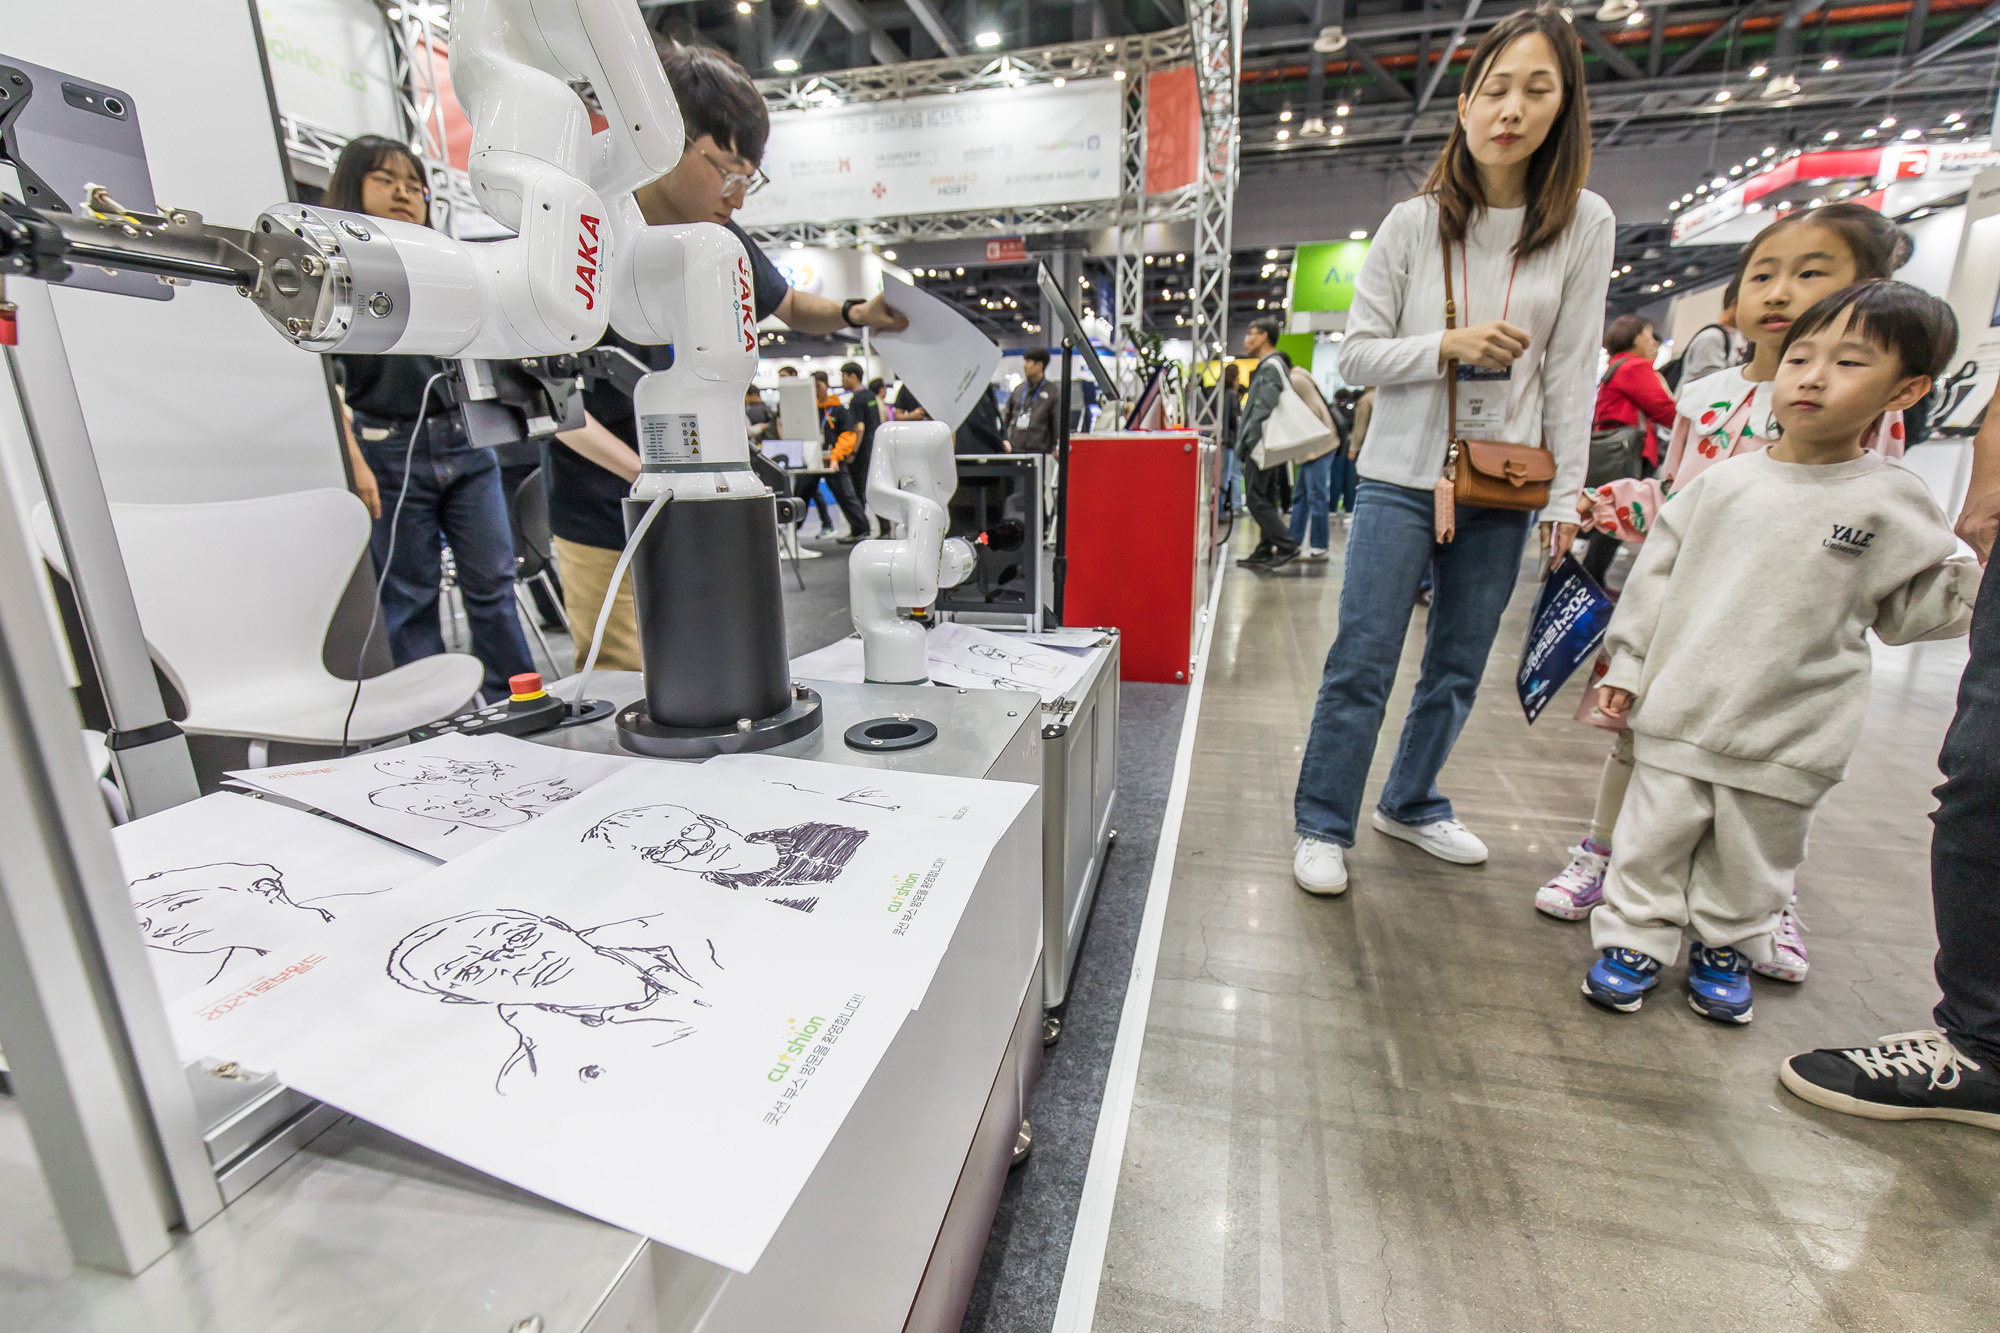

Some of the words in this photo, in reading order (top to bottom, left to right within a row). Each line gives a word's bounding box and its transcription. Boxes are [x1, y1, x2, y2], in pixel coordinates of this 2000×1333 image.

[574, 213, 600, 311] JAKA
[357, 294, 366, 316] POINT
[738, 256, 755, 352] JAKA
[1822, 539, 1864, 558] University
[887, 872, 921, 913] cutshion
[909, 889, 929, 908] 방문을
[901, 909, 918, 922] 부스
[762, 1100, 792, 1126] 쿳션
[781, 1078, 808, 1100] 부스
[798, 1044, 831, 1076] 방문을
[821, 993, 866, 1045] 환영합니다!!
[767, 1016, 826, 1083] cutshion
